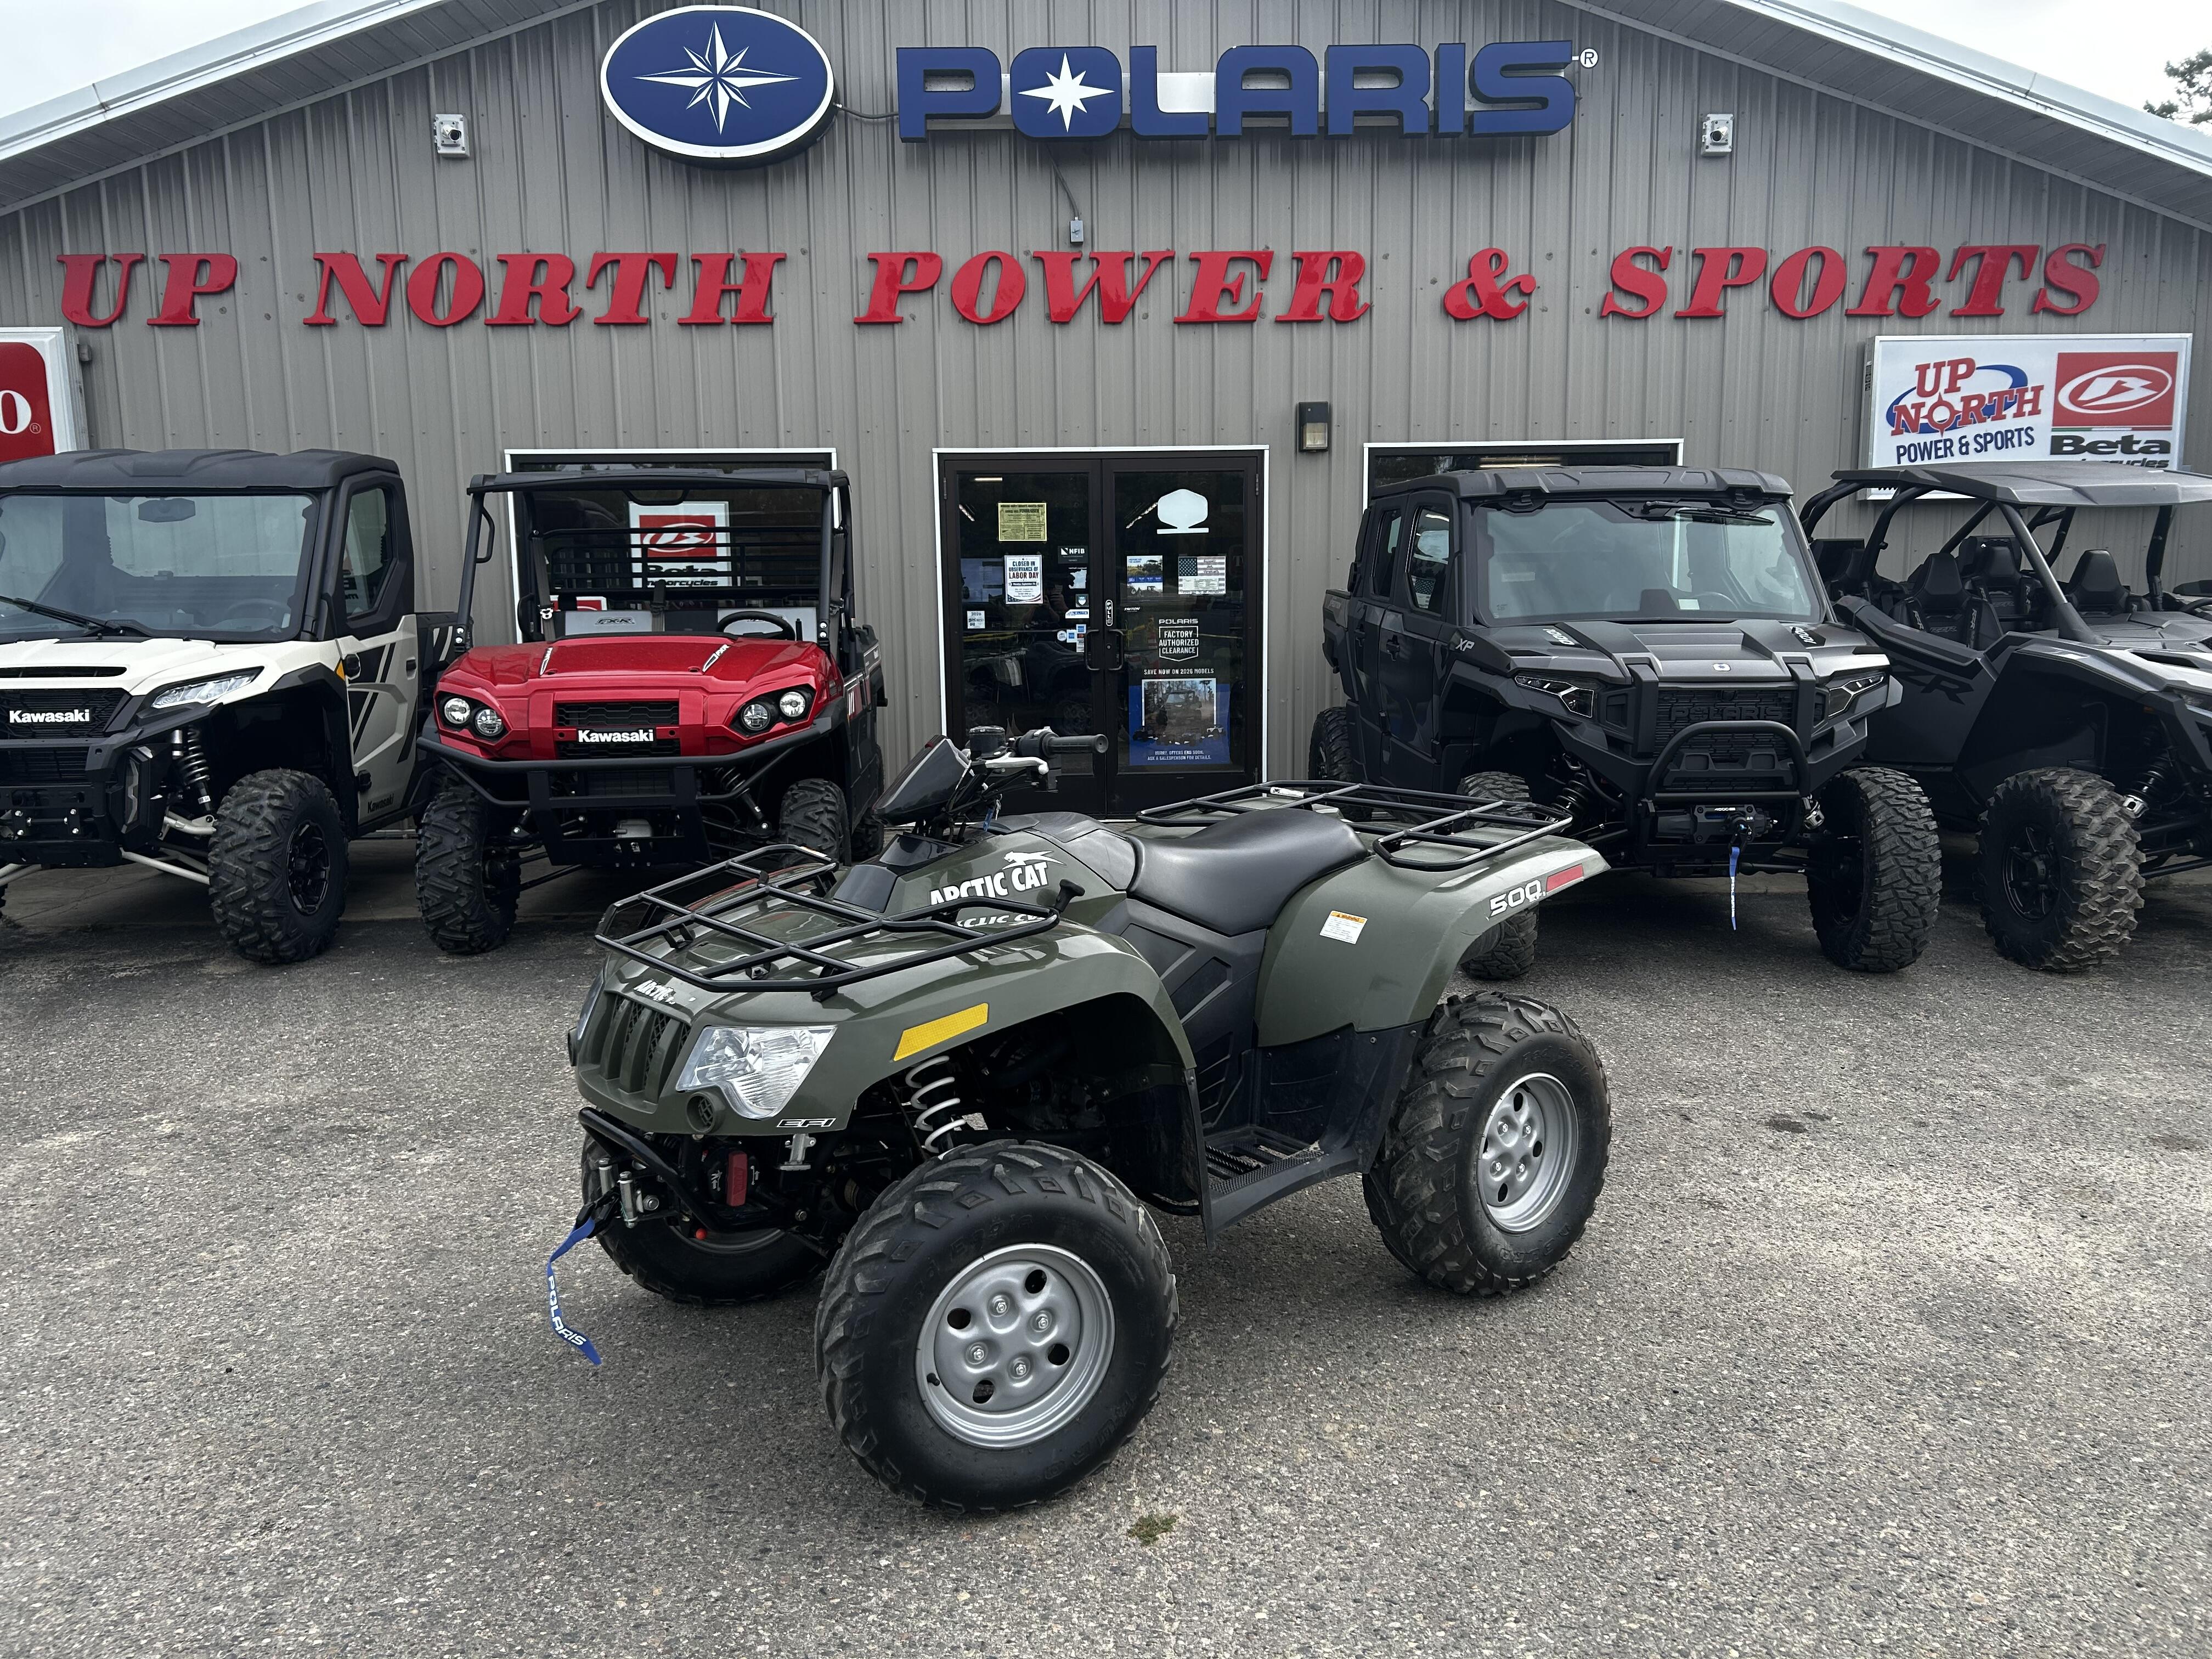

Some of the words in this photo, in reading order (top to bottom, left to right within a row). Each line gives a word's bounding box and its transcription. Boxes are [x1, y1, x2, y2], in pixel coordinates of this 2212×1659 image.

[897, 41, 1576, 143] POLARIS
[57, 253, 238, 327] UP
[303, 251, 787, 327] NORTH
[854, 250, 1370, 325] POWER
[1443, 247, 1537, 320] &
[1601, 243, 2107, 319] SPORTS
[1915, 358, 1976, 398] UP
[1891, 385, 2045, 437] NORTH
[1896, 438, 1955, 465] POWER
[1959, 436, 1970, 455] &
[1974, 426, 2036, 454] SPORTS
[2050, 434, 2171, 455] Beta
[647, 579, 718, 588] morcycles
[1159, 639, 1199, 647] AUTHORIZED
[1455, 638, 1475, 652] XP
[1543, 629, 1575, 645] 1000
[9, 709, 90, 723] Kawasaki
[1671, 706, 1782, 720] POLARIS
[578, 729, 654, 742] Kawasaki
[368, 793, 394, 814] Kawasaki
[930, 871, 1009, 905] ARCTIC
[1011, 861, 1049, 892] CAT
[776, 1118, 837, 1128] EFI
[548, 1276, 587, 1346] POLARIS
